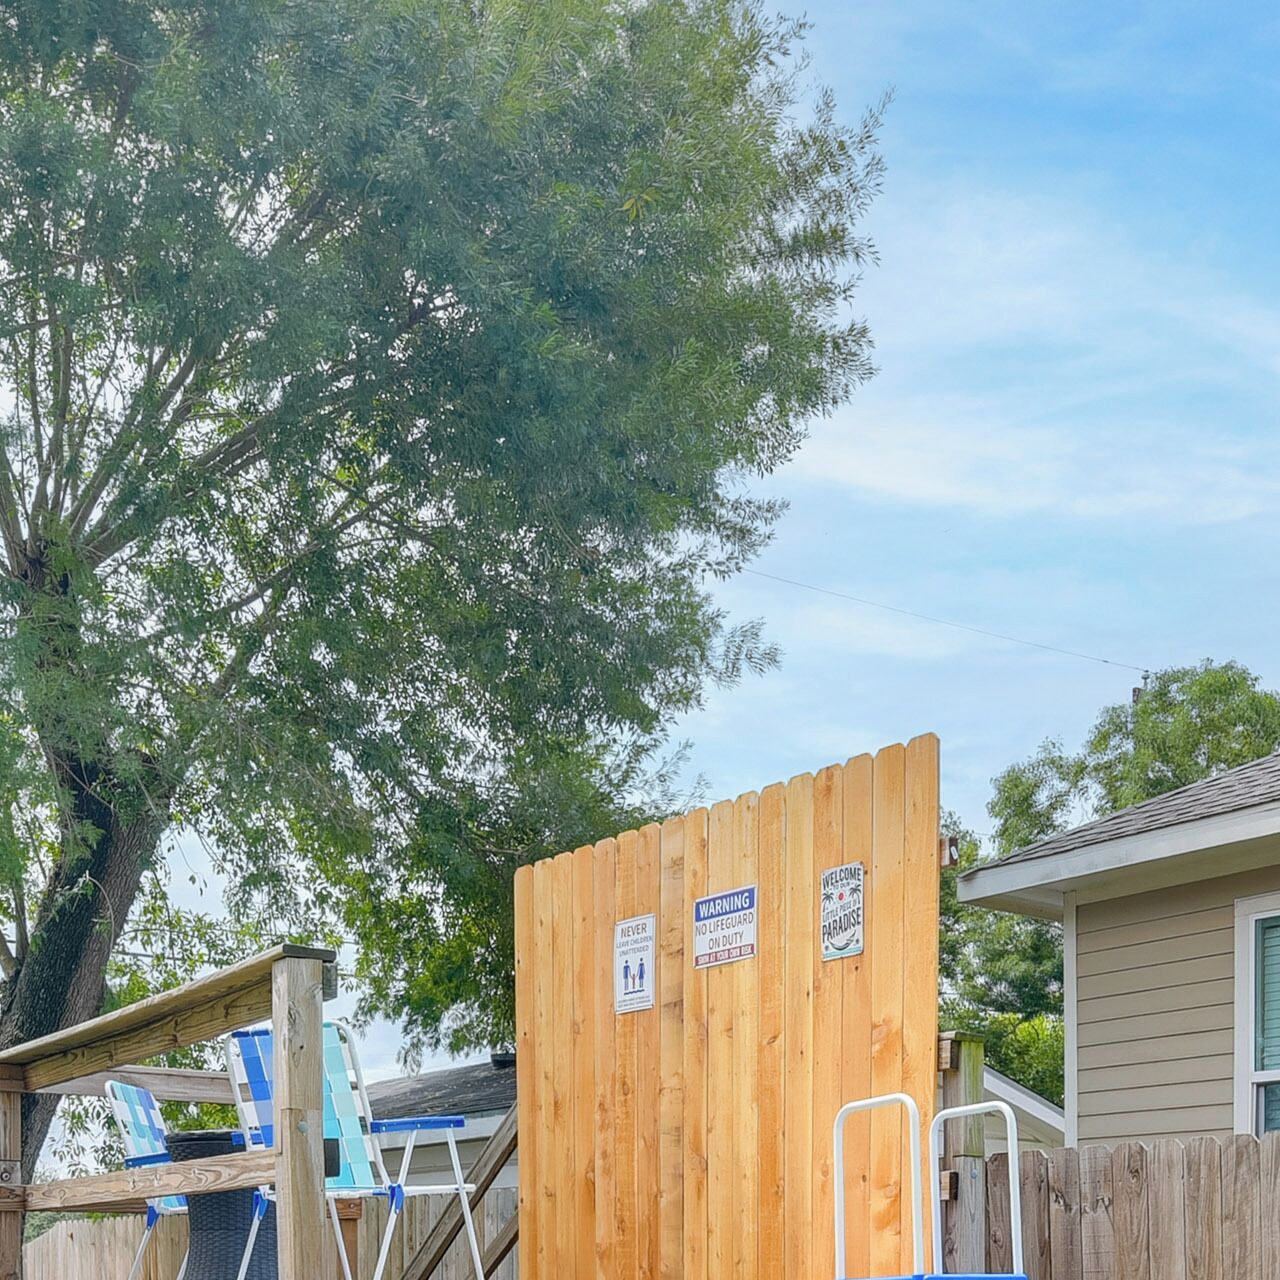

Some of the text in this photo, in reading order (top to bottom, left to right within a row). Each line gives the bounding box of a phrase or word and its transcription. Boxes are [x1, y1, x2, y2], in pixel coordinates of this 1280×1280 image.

[823, 867, 861, 890] WELCOME
[699, 892, 750, 918] WARNING
[823, 905, 839, 923] LITTLE
[621, 922, 647, 939] NEVER
[695, 912, 754, 937] NO LIFEGUARD
[822, 907, 861, 944] PARADISE
[616, 935, 653, 949] LEAVE CHILDREN
[708, 931, 744, 950] ON DUTY
[619, 945, 650, 957] UNATTENDED
